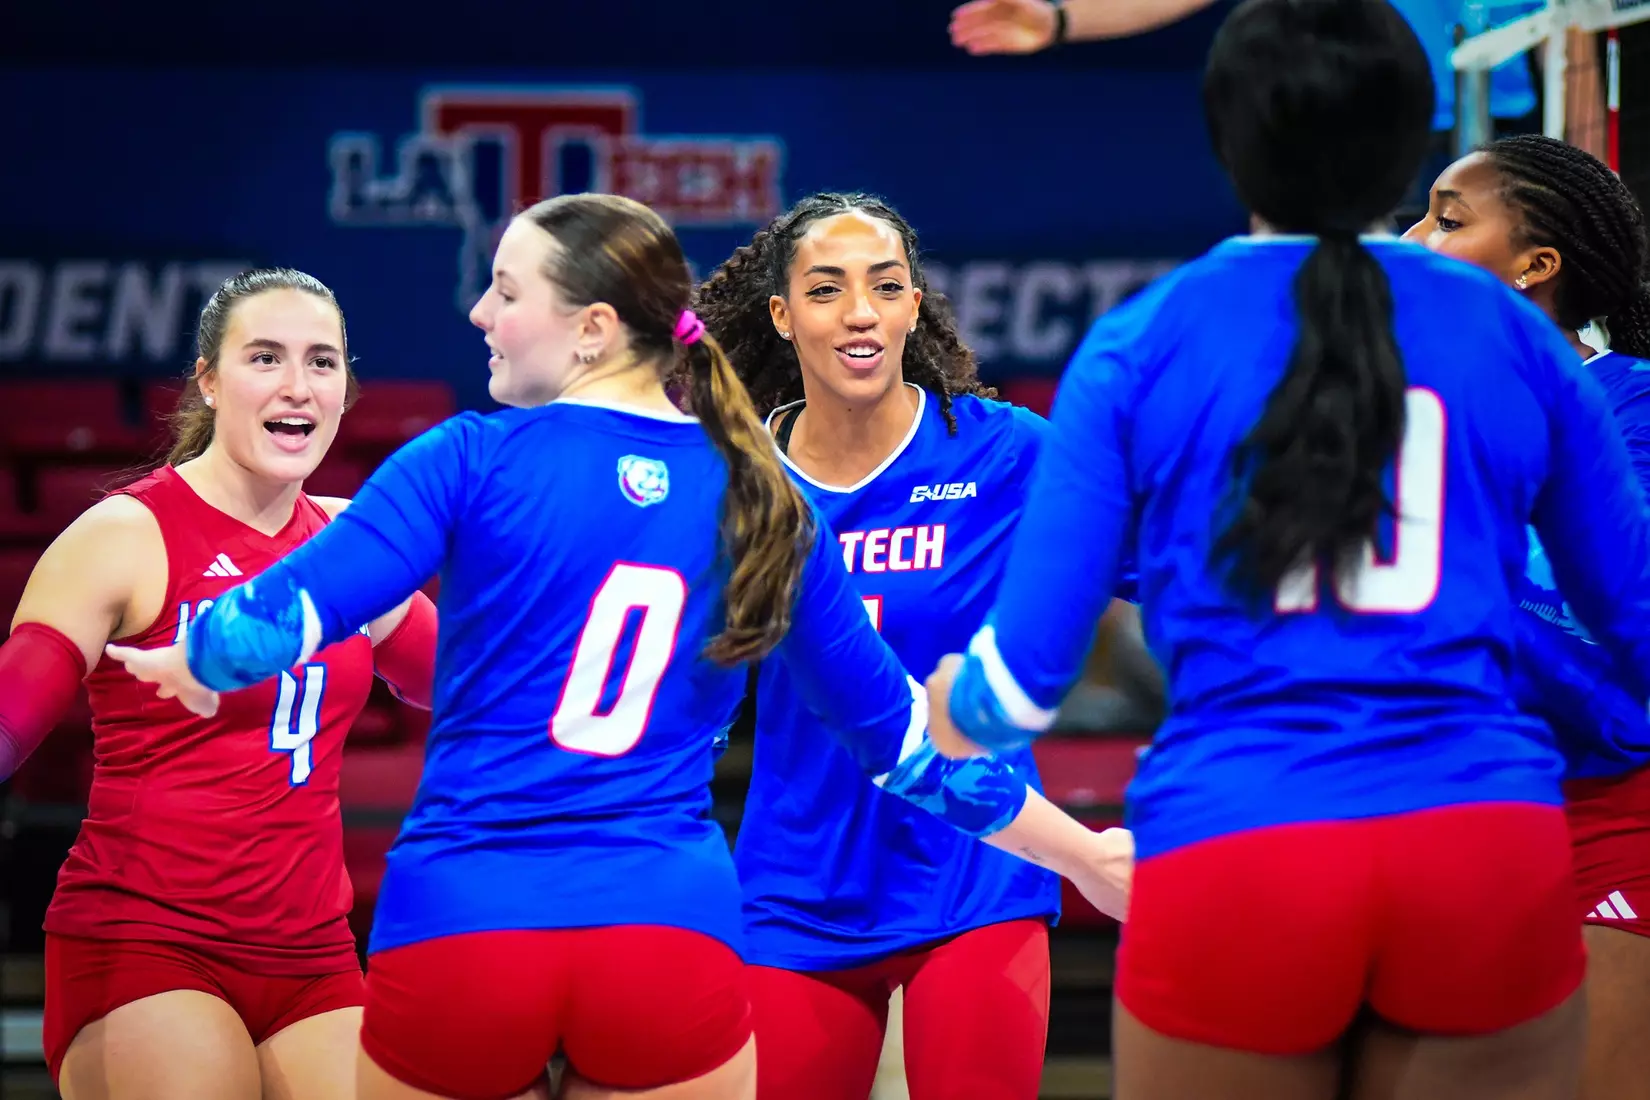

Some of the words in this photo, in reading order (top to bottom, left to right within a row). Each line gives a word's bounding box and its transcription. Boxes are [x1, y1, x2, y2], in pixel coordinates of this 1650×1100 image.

[839, 523, 946, 574] TECH
[548, 560, 688, 758] 0
[268, 661, 327, 787] 4
